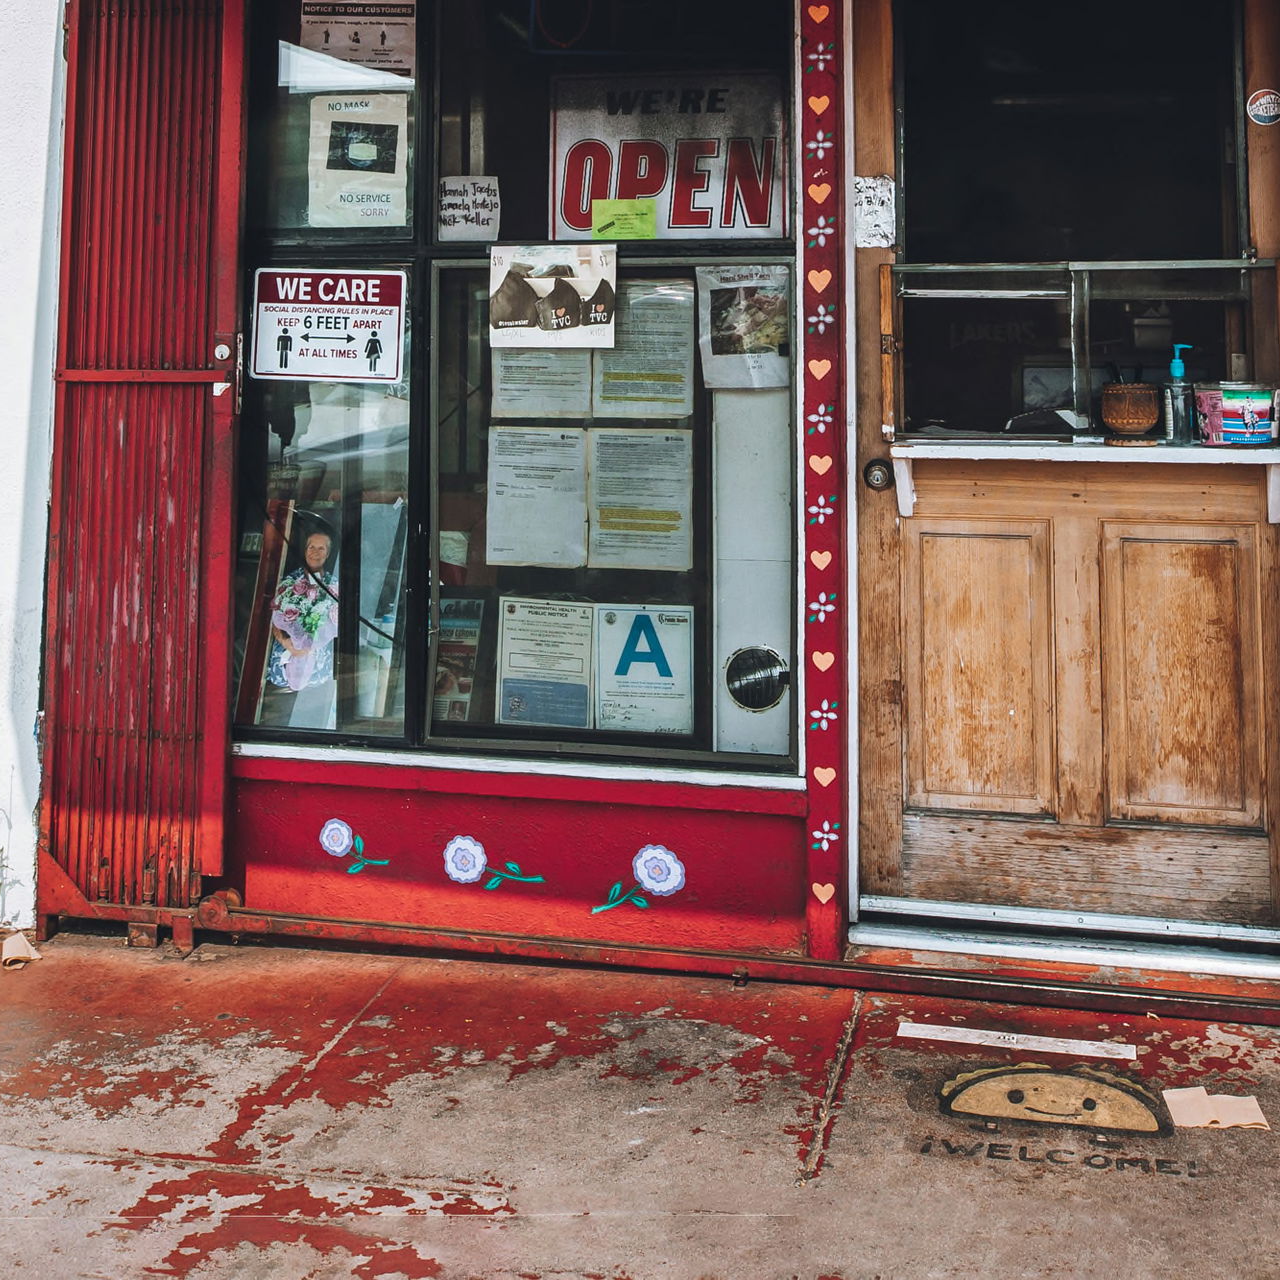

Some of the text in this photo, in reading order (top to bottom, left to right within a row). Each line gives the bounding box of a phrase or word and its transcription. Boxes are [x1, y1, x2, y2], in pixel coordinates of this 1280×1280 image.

[328, 101, 369, 111] NO MASK
[607, 89, 729, 115] WE'RE
[561, 137, 777, 231] OPEN
[340, 194, 391, 203] NO SERVICE
[360, 208, 389, 217] SORRY
[276, 278, 380, 302] WE CARE
[278, 315, 382, 330] KEEP 6 FEET APART
[551, 316, 571, 329] TVC
[590, 313, 607, 322] TVC
[299, 349, 357, 359] AT ALL TIMES
[614, 615, 673, 677] A
